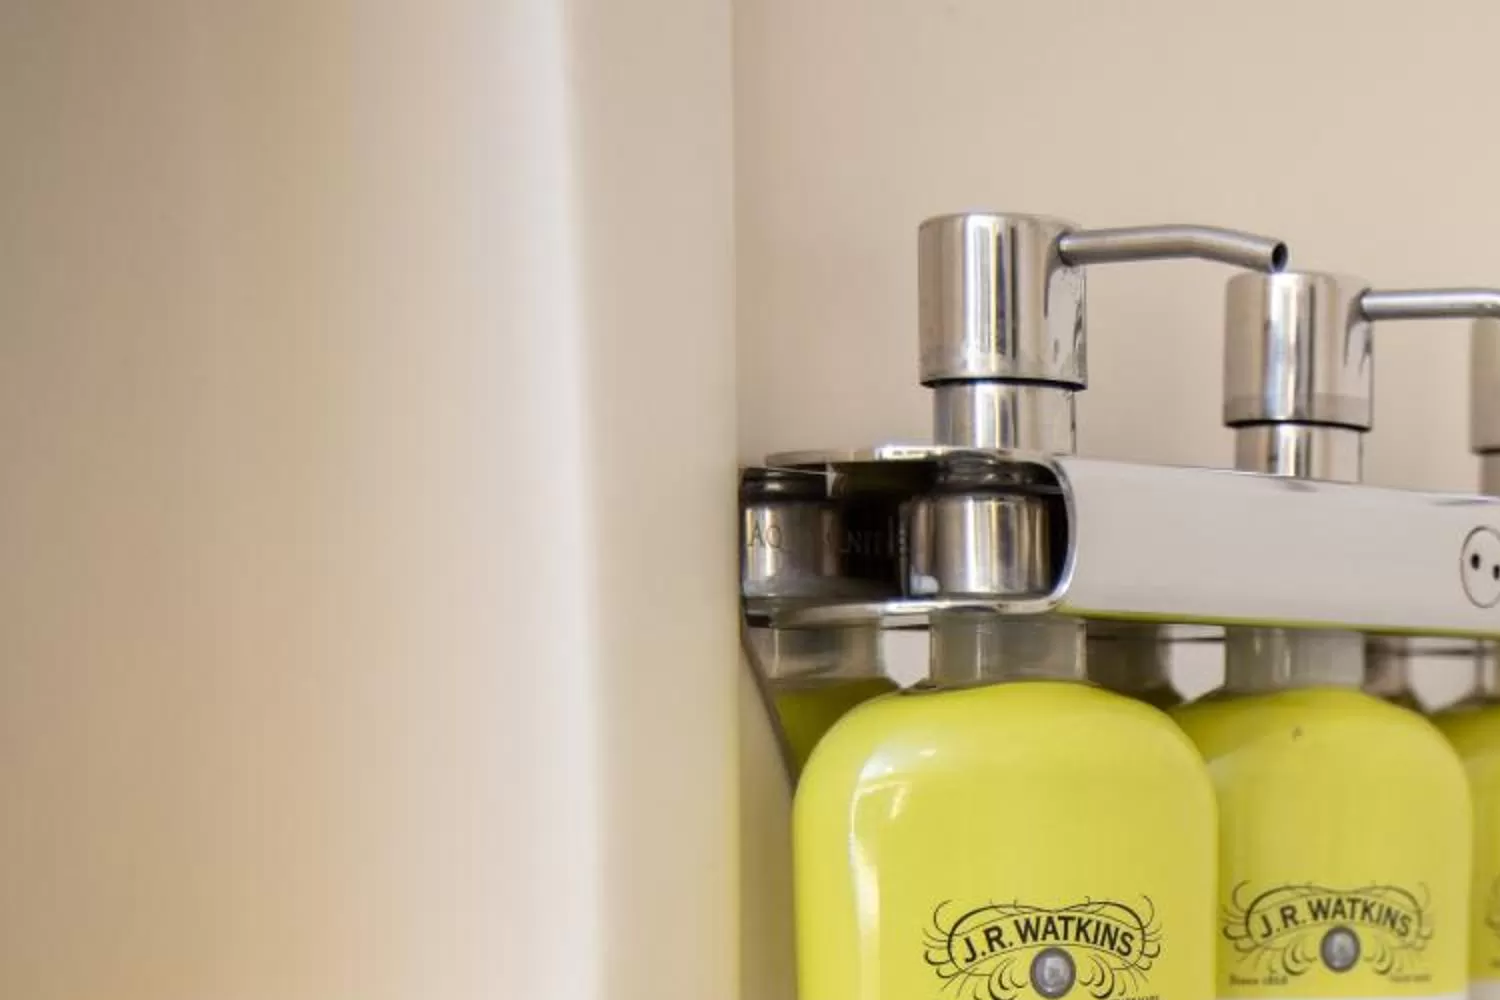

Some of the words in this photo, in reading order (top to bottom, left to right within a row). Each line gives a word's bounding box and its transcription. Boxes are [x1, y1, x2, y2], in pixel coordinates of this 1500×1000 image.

[1308, 896, 1413, 937] WATKINS
[963, 925, 1013, 963] J.R.
[1014, 915, 1136, 957] WATKINS
